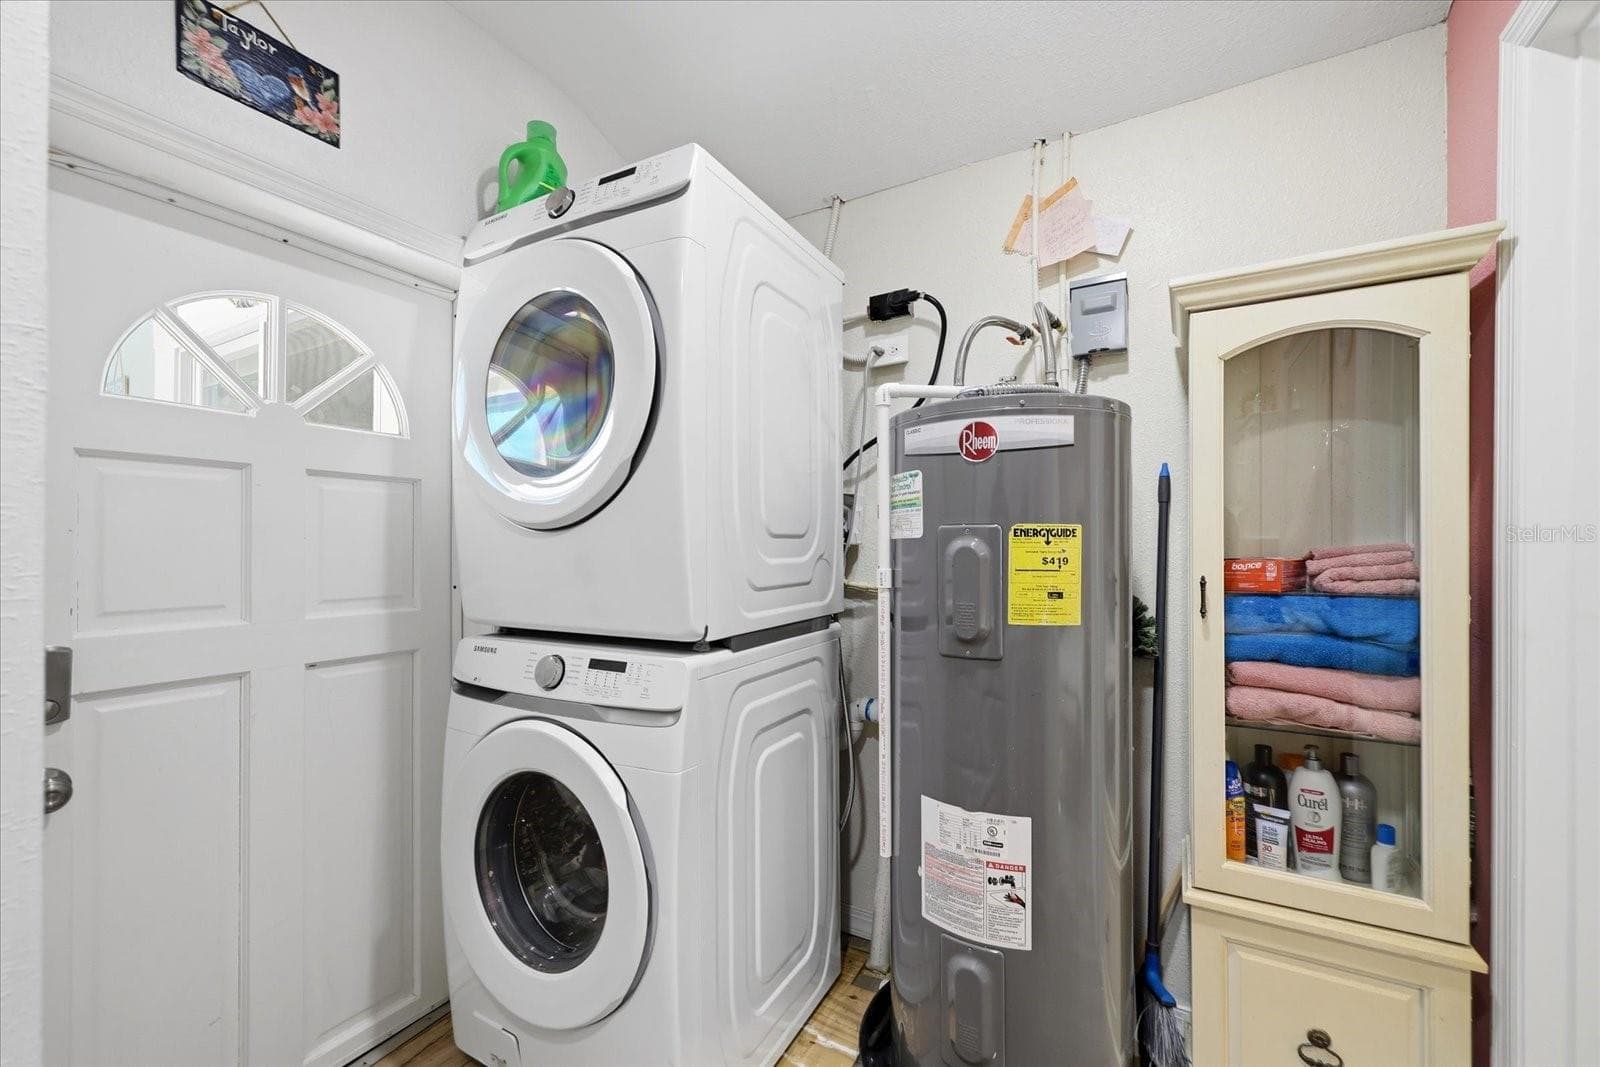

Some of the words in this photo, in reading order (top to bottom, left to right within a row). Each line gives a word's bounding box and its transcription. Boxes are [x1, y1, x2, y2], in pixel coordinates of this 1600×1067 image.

[211, 7, 278, 55] Taylor
[1014, 417, 1069, 426] PROFESSIONA
[962, 422, 997, 456] Rheem
[1013, 528, 1078, 538] ENERGYGUIDE
[1041, 556, 1069, 566] $419
[1231, 562, 1263, 571] bounce
[473, 645, 498, 654] SAMSUNG
[1297, 793, 1329, 811] Curél
[1262, 843, 1273, 853] 30
[995, 863, 1025, 872] DANGER
